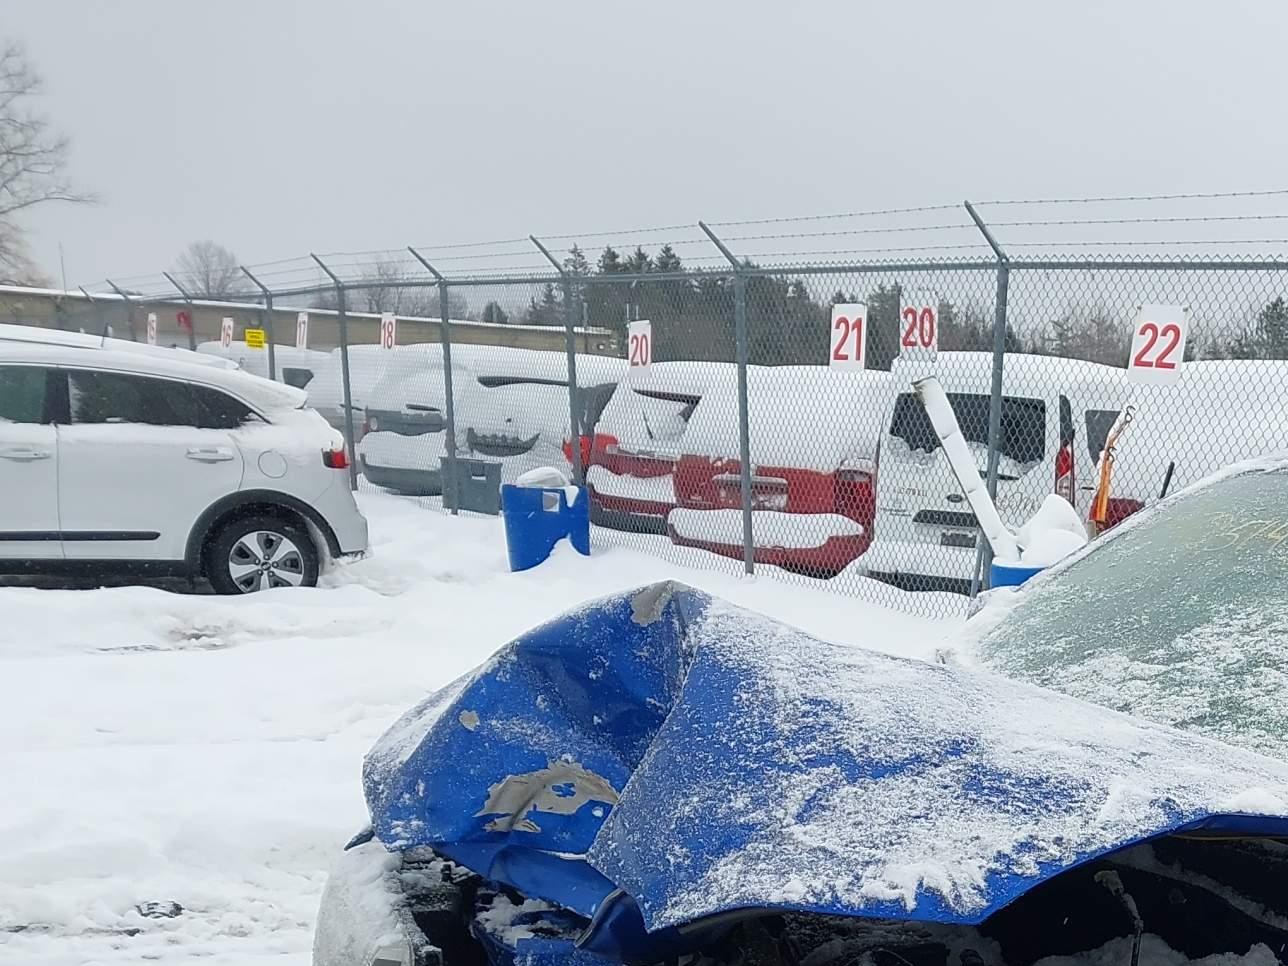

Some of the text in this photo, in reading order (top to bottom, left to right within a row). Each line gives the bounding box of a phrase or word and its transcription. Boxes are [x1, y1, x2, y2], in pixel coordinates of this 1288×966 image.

[222, 323, 233, 348] 16
[297, 319, 307, 345] 17
[381, 320, 394, 350] 18
[832, 317, 863, 361] 21
[902, 306, 935, 347] 20
[630, 333, 649, 367] 20
[1132, 322, 1182, 370] 22
